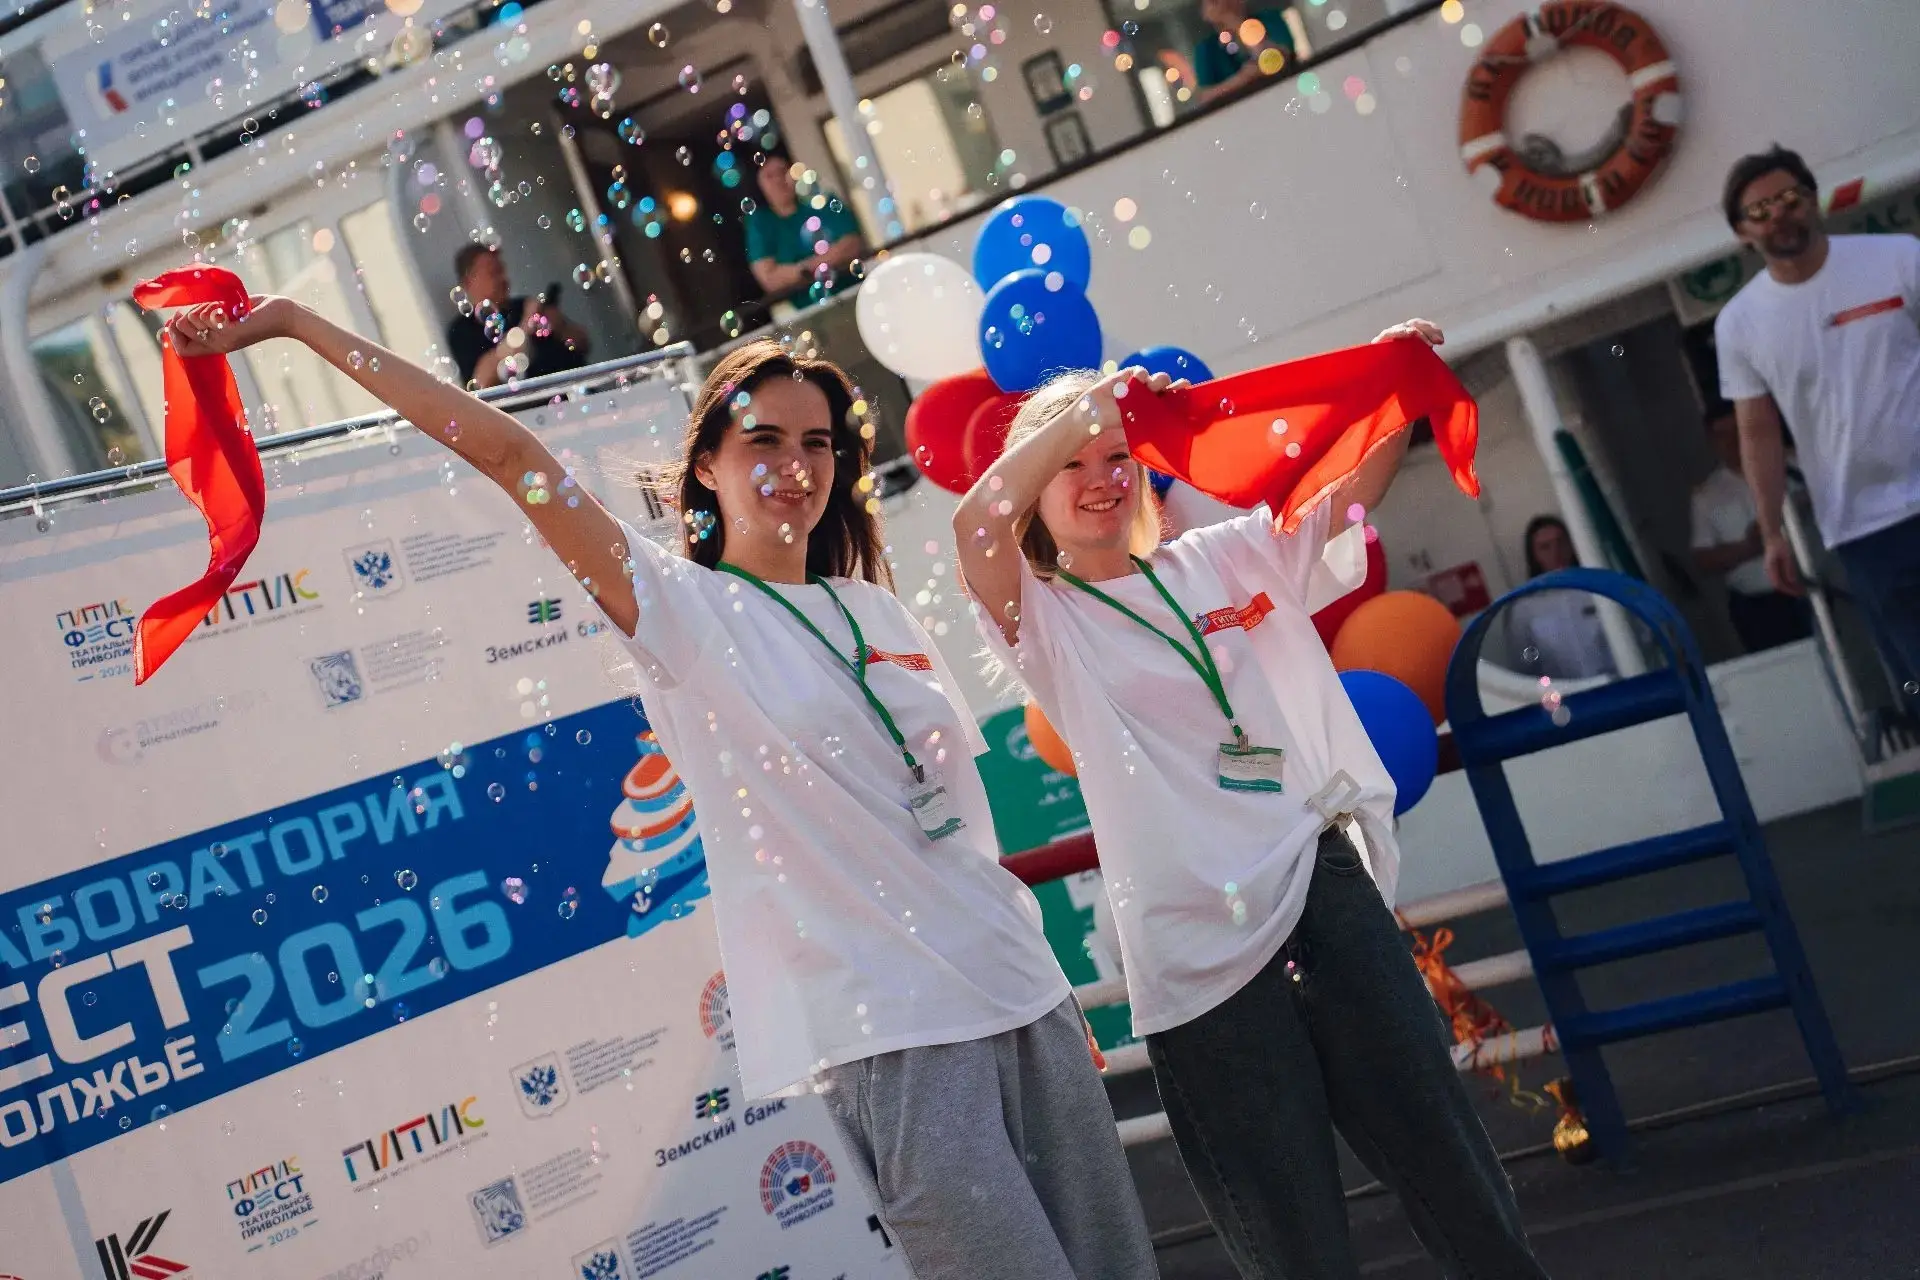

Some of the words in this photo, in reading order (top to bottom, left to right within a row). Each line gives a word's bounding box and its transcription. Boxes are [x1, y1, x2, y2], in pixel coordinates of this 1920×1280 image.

[204, 567, 319, 626] ИТИС
[71, 638, 133, 658] ТЕАТРАЛЬН
[71, 648, 133, 668] ПРИВОЛЖ
[485, 626, 569, 664] Земский
[197, 869, 512, 1064] 2026
[341, 1095, 486, 1183] ГИТИС
[654, 1117, 736, 1168] Земский
[744, 1097, 788, 1126] банк
[233, 1173, 303, 1217] ФЕСТ
[237, 1192, 312, 1230] ТЕАТРАЛЬНОЕ
[240, 1203, 315, 1241] ПРИВОЛЖЬЕ
